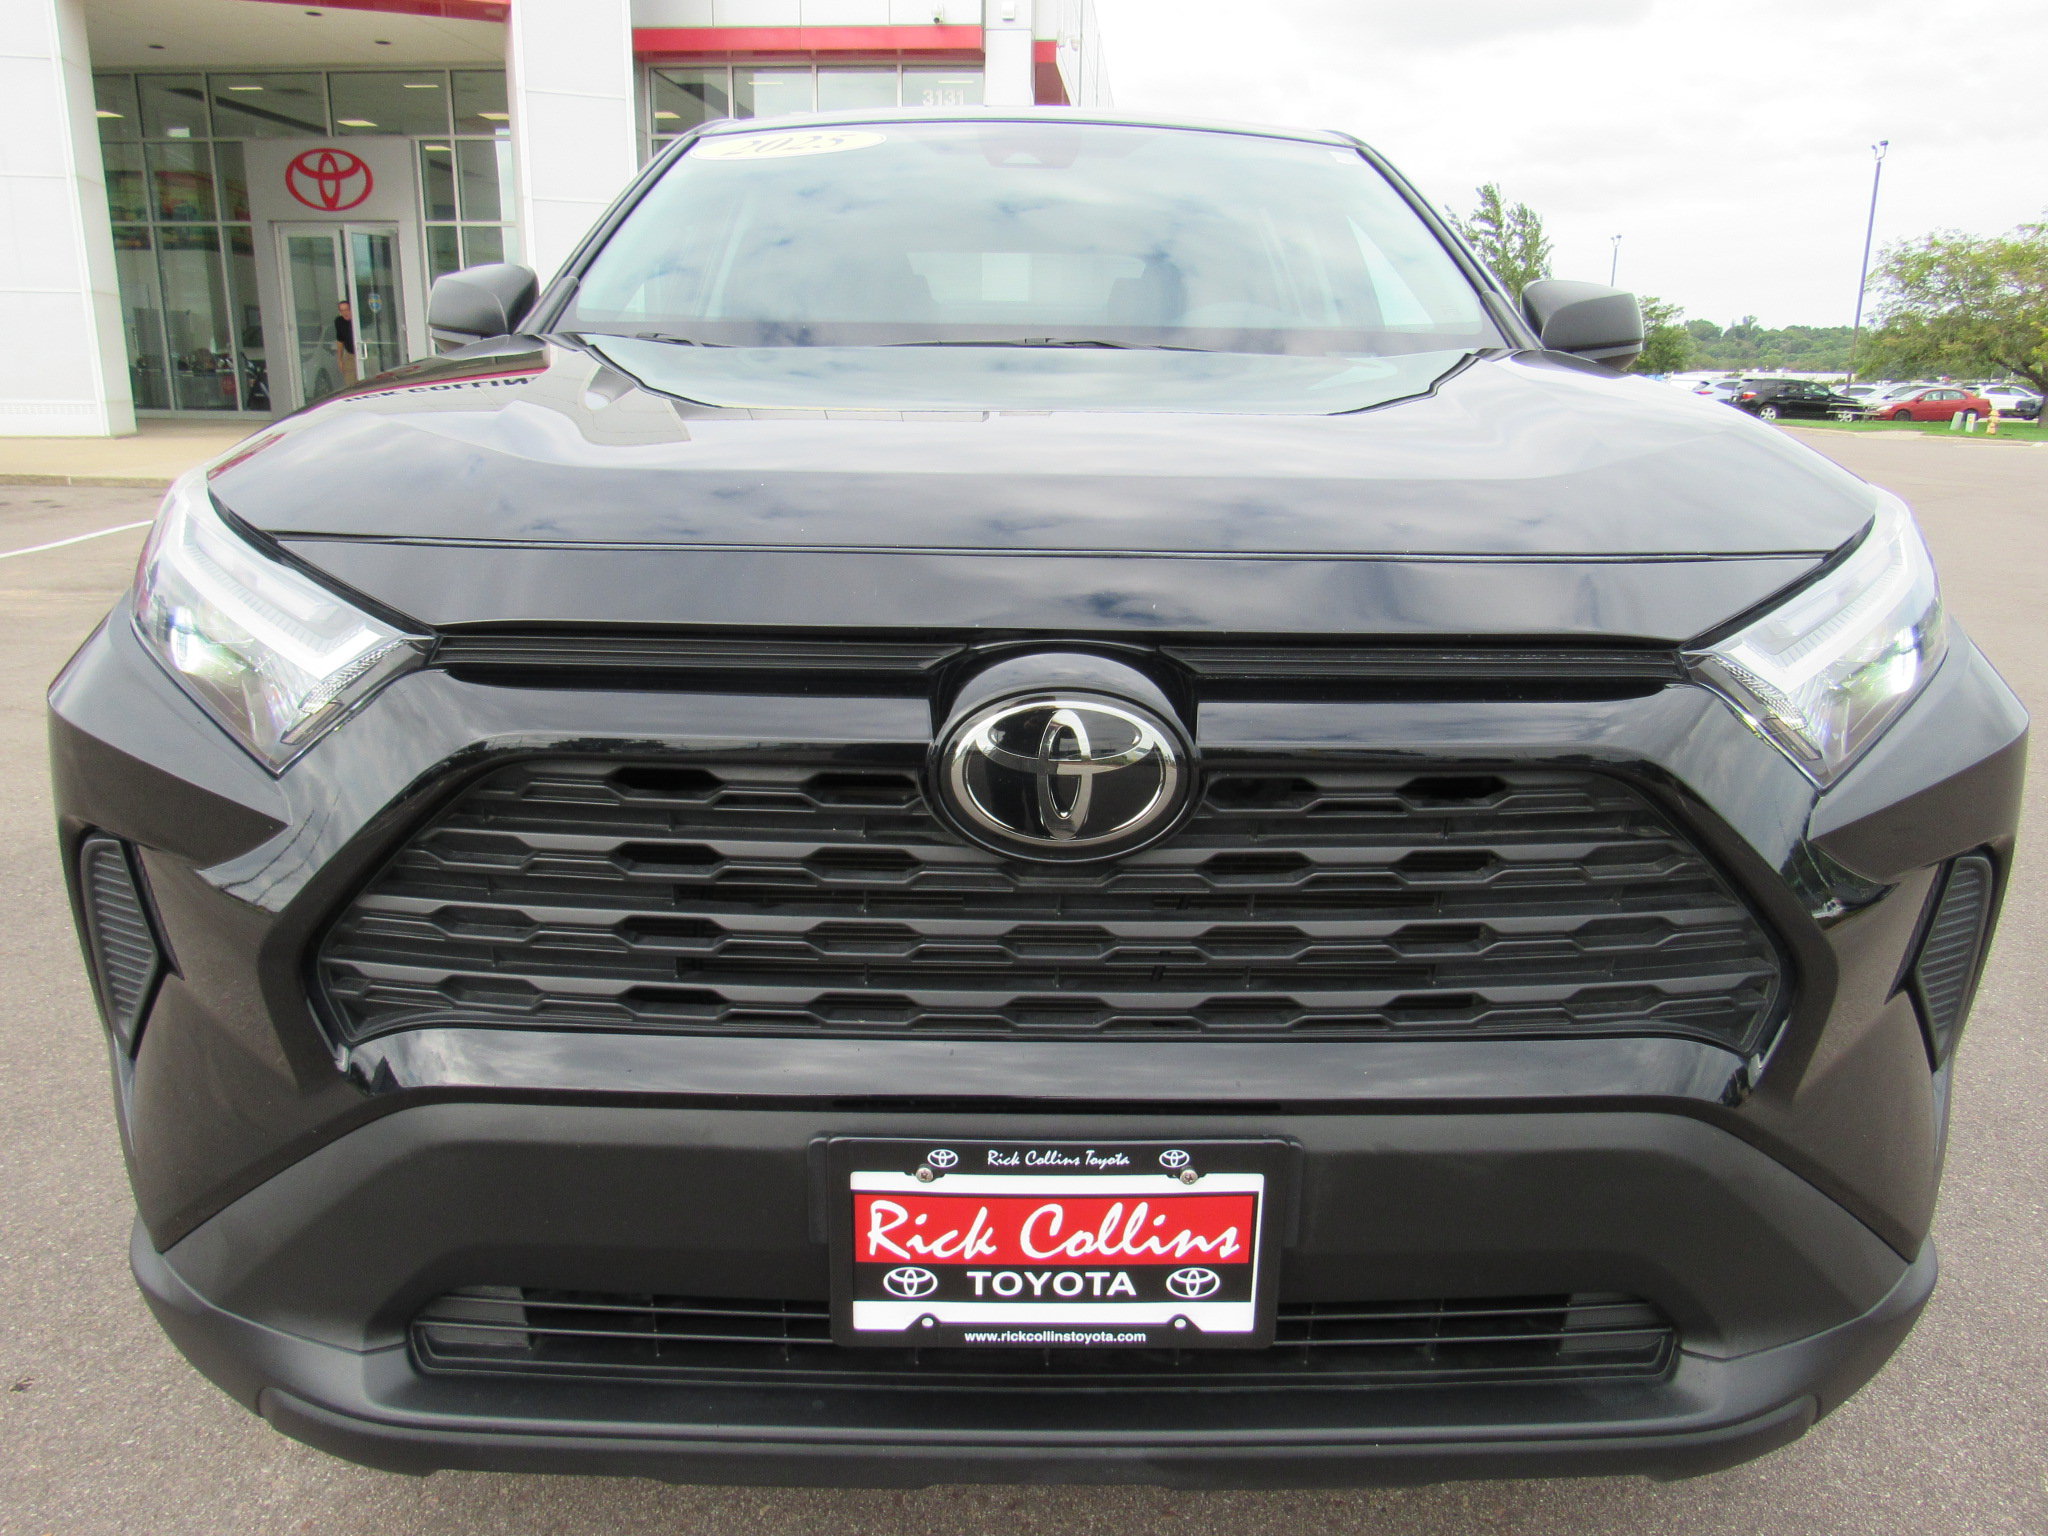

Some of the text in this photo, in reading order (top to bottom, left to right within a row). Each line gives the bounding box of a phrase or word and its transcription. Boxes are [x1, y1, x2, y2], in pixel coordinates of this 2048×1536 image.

[923, 88, 964, 105] 3131
[987, 1149, 1130, 1169] Rick Collins Toyota
[867, 1199, 1241, 1260] Rick Collins
[966, 1271, 1138, 1296] TOYOTA
[964, 1330, 1147, 1344] www.rickcollinstoyota.com
